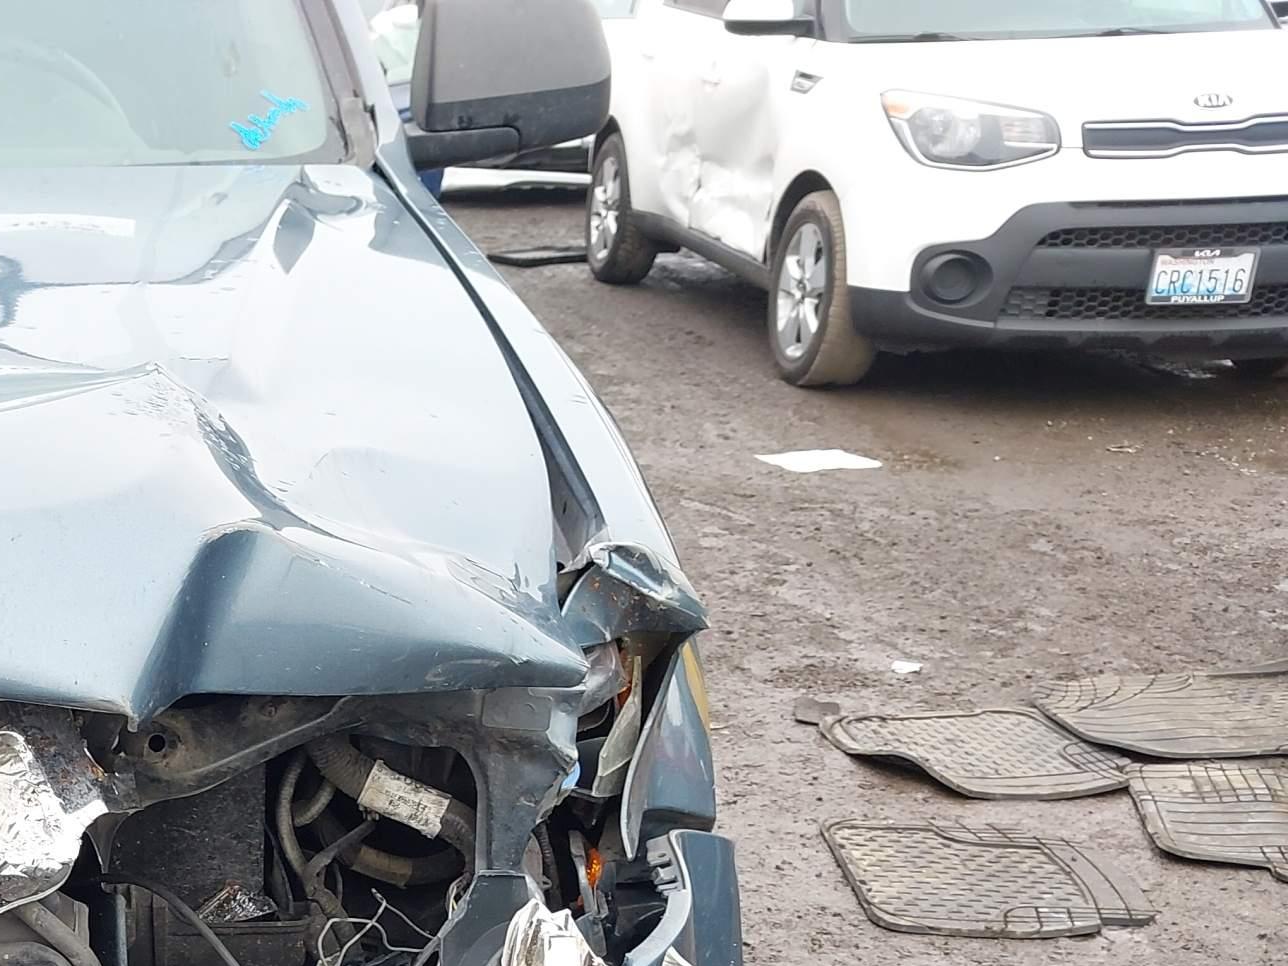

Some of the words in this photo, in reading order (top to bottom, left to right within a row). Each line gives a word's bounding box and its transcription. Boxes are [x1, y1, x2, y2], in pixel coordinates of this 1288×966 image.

[1193, 93, 1233, 108] KIA
[1155, 268, 1246, 294] CRC1516
[1171, 295, 1224, 303] PUYALLUP
